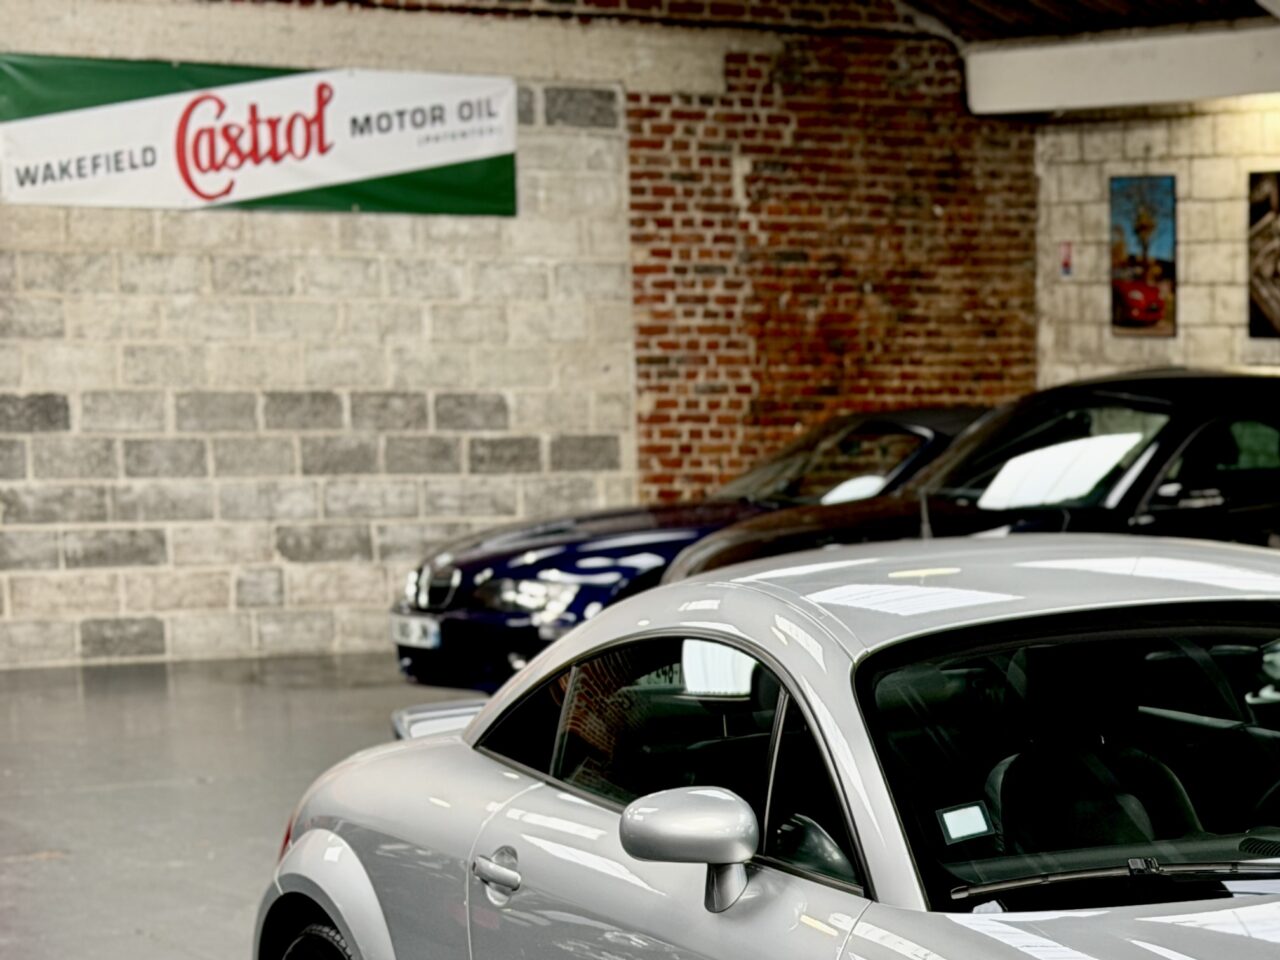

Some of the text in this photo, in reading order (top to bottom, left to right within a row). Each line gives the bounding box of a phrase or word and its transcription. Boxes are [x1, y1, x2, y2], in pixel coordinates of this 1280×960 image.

[15, 147, 157, 187] WAKEFIELD
[176, 82, 334, 201] Castrol
[350, 104, 445, 137] MOTOR
[457, 97, 498, 121] OIL
